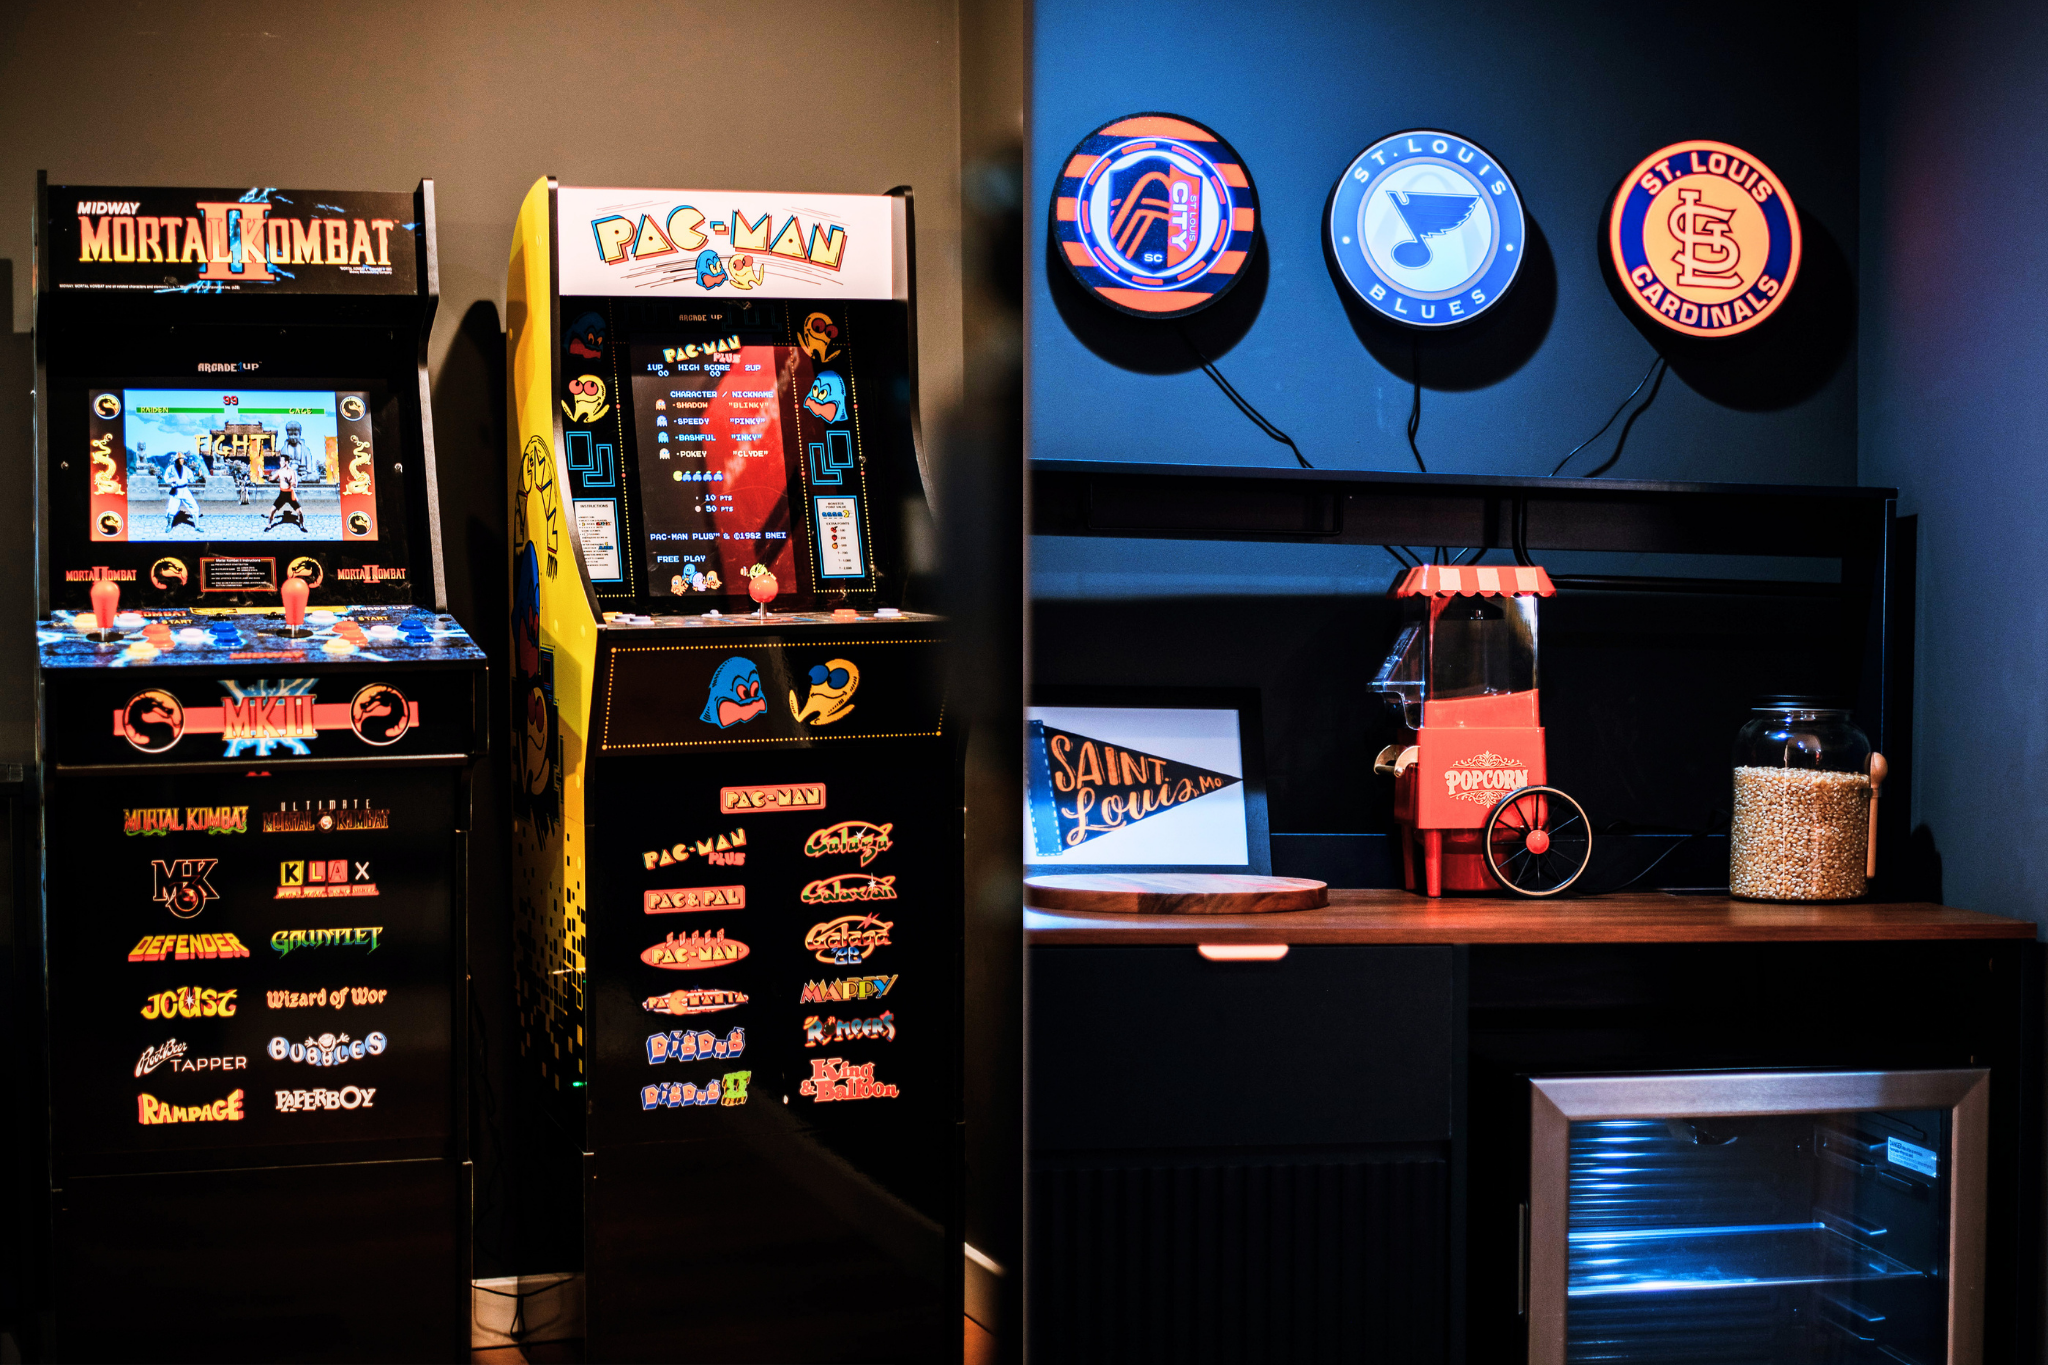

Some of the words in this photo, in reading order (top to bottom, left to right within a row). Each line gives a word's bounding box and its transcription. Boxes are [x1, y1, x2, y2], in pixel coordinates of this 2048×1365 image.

[1354, 150, 1398, 183] ST.
[1408, 139, 1507, 196] LOUIS
[1640, 160, 1682, 195] ST.
[1690, 152, 1773, 203] LOUIS
[77, 202, 140, 215] MIDWAY
[1190, 195, 1197, 211] ST
[1171, 182, 1189, 252] CITY
[1189, 212, 1197, 242] LOUIS
[78, 217, 234, 264] MORTAL
[238, 219, 394, 265] KOMBAT
[591, 204, 848, 272] PAC-MAN
[1144, 254, 1163, 262] SC
[1369, 284, 1486, 319] BLUES
[1631, 264, 1780, 328] CARDINALS
[662, 335, 742, 364] PAC-MAN
[713, 352, 742, 364] PLUS
[647, 364, 664, 372] 1UP
[223, 395, 239, 405] 99
[194, 434, 277, 457] FIGHT!
[657, 555, 680, 563] FREE
[337, 568, 371, 580] MORTAL
[1051, 735, 1167, 792] SAINT
[1444, 769, 1529, 795] POPCORN
[281, 799, 371, 811] ULTIMATE
[725, 786, 821, 809] PAC-MAN
[123, 808, 184, 832] MORTAL
[186, 806, 249, 832] KOMBAT
[642, 827, 747, 870] PAC-MAN
[708, 852, 746, 866] PLUS
[283, 861, 370, 885] KLAX
[648, 891, 687, 909] PAC
[687, 891, 701, 907] &
[702, 888, 741, 906] PAL
[128, 932, 250, 962] DEFENDER
[270, 926, 383, 959] GAUNTLET
[666, 928, 725, 948] SUPER
[652, 944, 740, 964] PAC-MAN
[266, 988, 326, 1009] Wizard
[329, 986, 349, 1009] of
[351, 986, 387, 1006] Wor
[800, 974, 899, 1003] MAPPY
[267, 1031, 388, 1067] BUBBLES
[170, 1056, 247, 1073] TAPPER
[810, 1057, 875, 1082] King
[275, 1085, 376, 1112] PAPERBOY
[800, 1079, 816, 1095] &
[814, 1075, 900, 1103] Balloon
[137, 1088, 245, 1125] RAMPAGE
